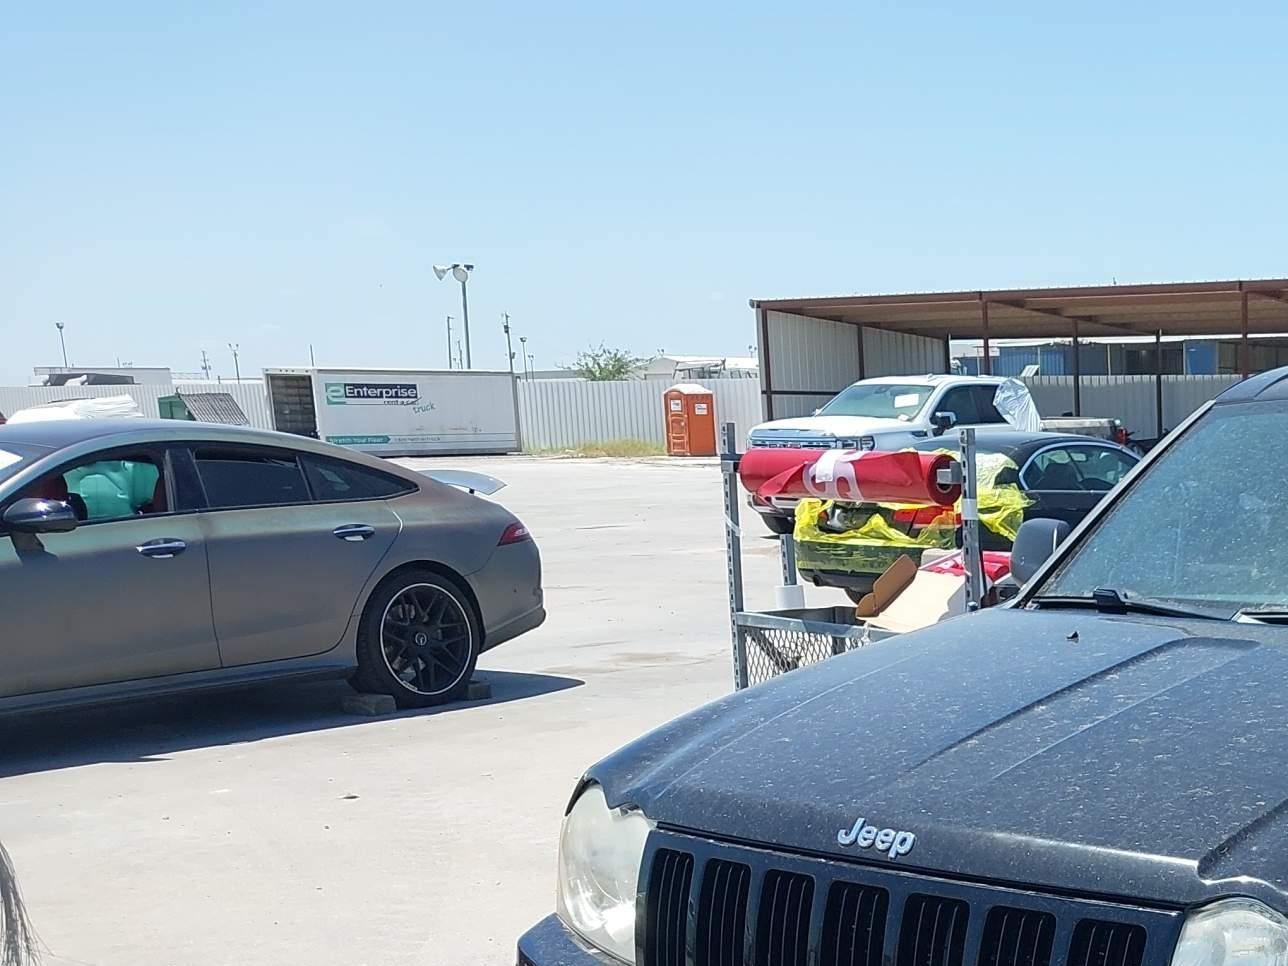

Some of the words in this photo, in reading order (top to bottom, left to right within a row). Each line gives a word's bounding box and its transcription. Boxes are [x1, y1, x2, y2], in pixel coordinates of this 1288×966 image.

[345, 385, 417, 399] Enterprise
[412, 401, 436, 414] truck
[837, 817, 916, 859] Jeep
